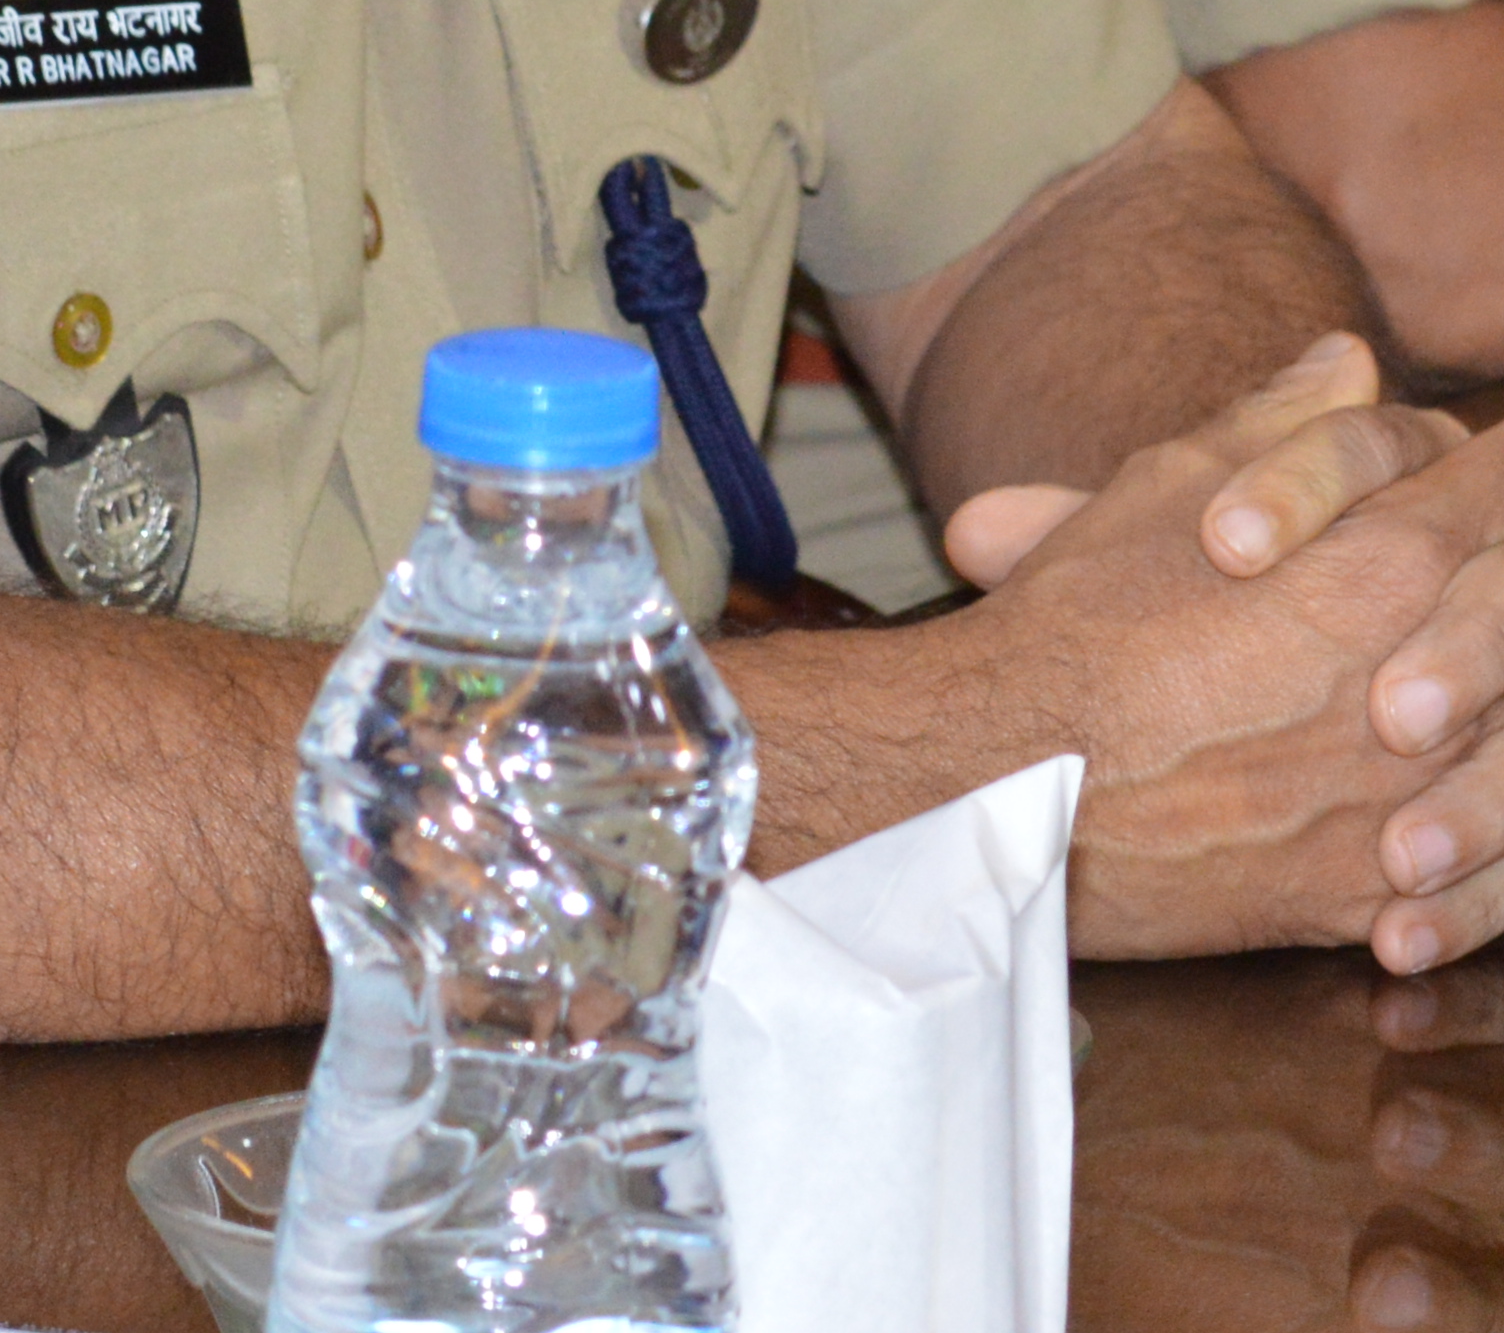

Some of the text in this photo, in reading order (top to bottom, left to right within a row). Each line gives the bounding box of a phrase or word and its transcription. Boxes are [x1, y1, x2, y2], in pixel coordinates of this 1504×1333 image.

[50, 10, 100, 45] राय
[106, 1, 202, 40] भटनागर
[15, 55, 36, 87] R
[39, 42, 197, 85] BHATNAGAR
